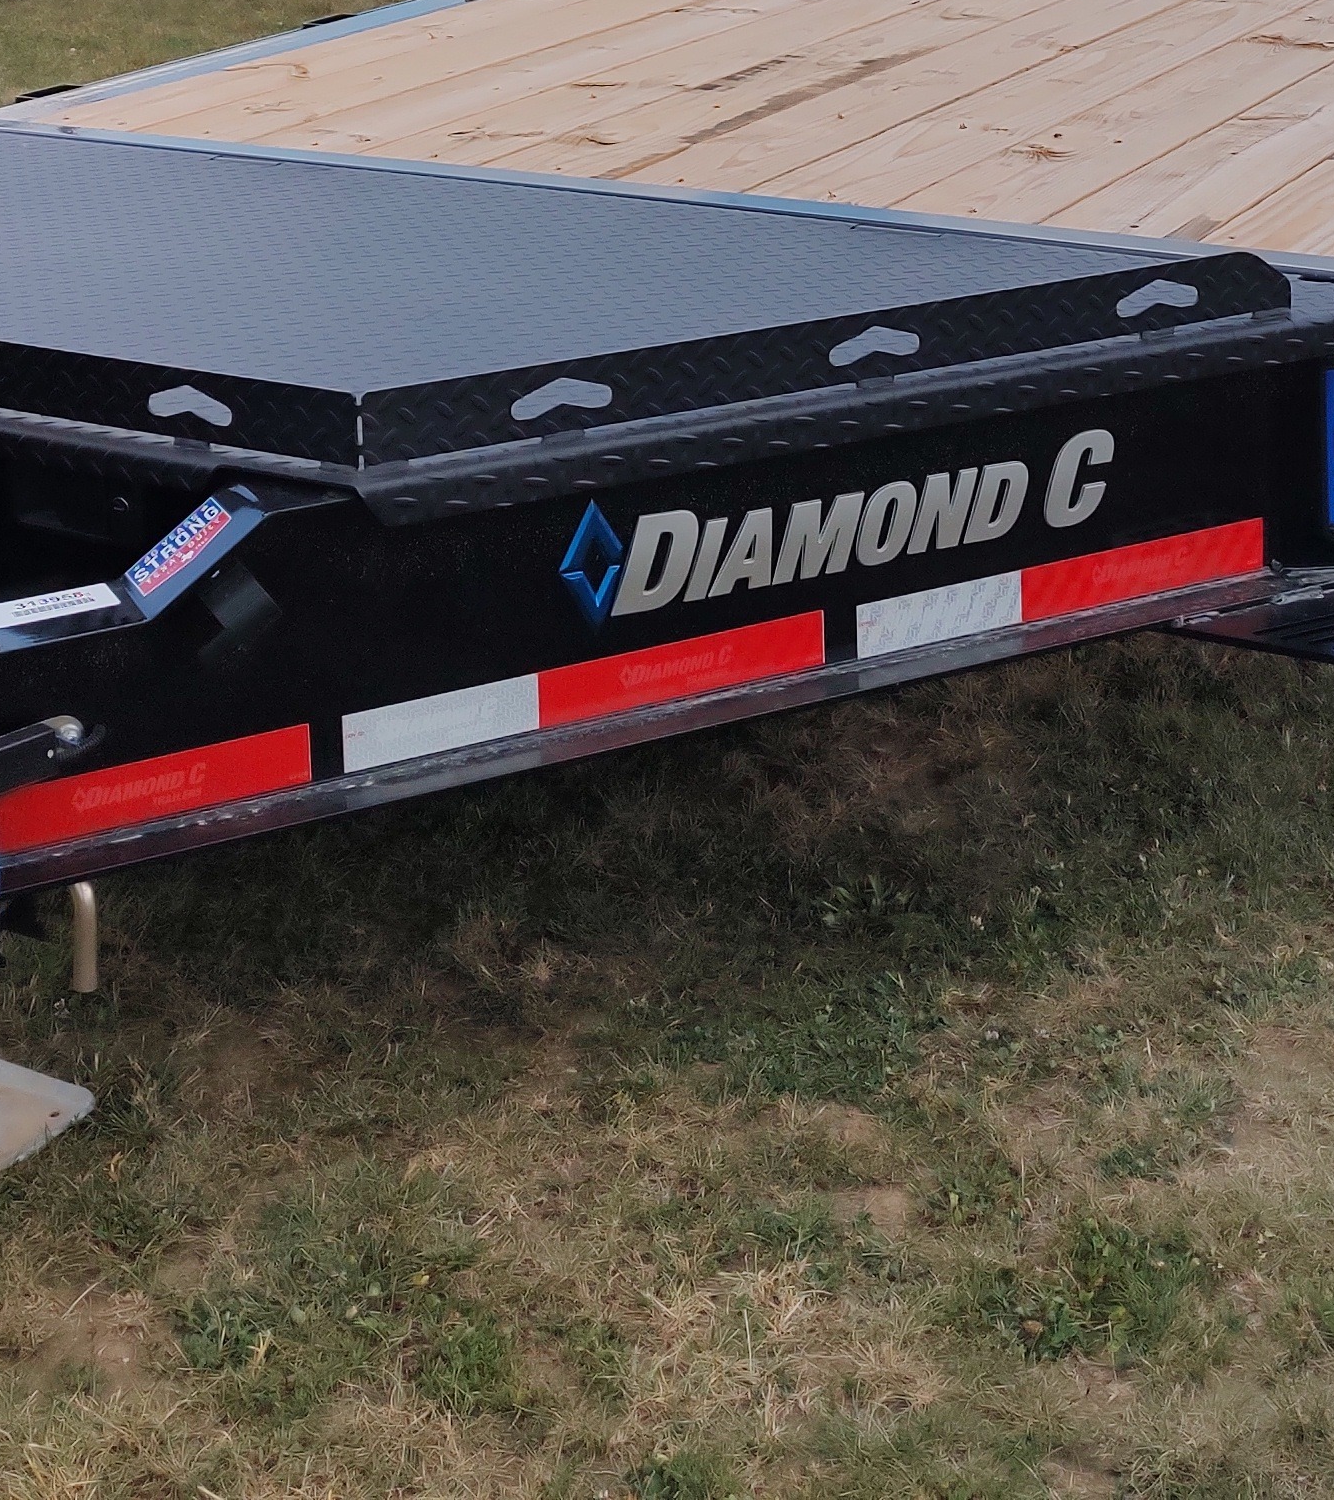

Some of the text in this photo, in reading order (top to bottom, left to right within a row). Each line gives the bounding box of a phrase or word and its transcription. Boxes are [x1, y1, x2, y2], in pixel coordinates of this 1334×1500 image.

[134, 505, 220, 583] STRONG
[610, 428, 1115, 617] DIAMOND C
[189, 761, 207, 786] C
